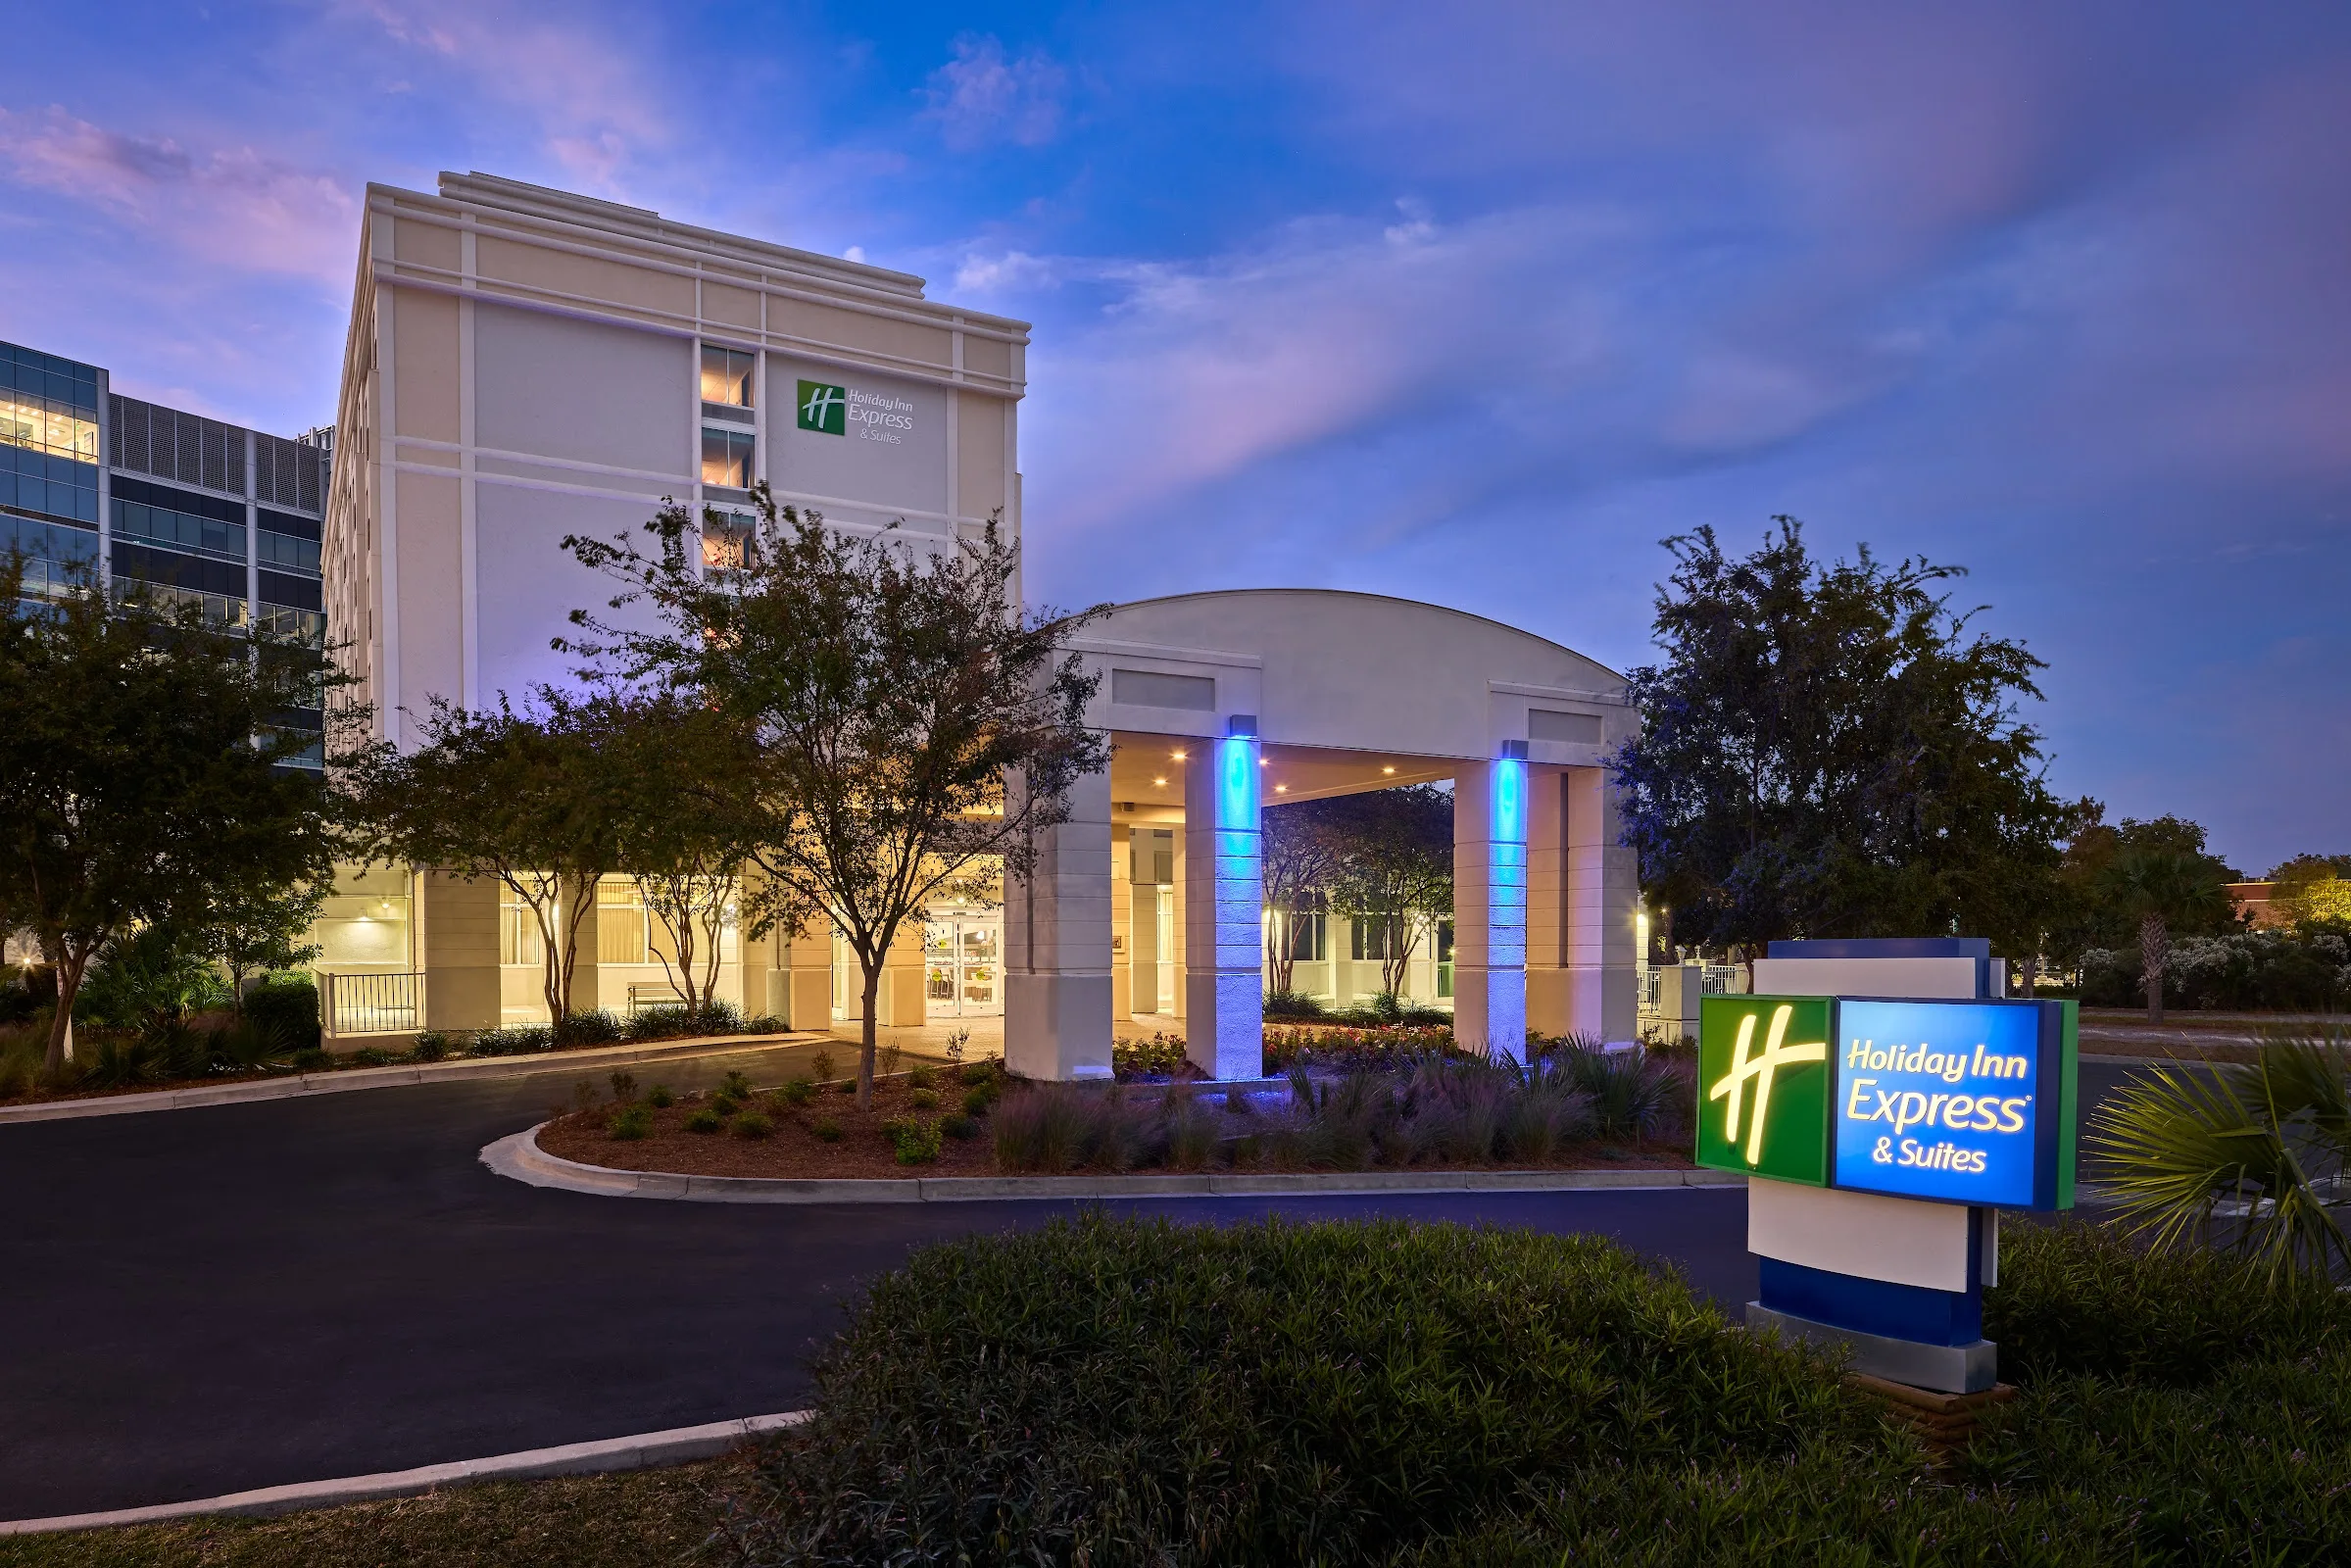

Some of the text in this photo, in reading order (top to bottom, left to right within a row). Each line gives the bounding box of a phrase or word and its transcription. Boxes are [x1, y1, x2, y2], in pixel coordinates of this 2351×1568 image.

[848, 389, 913, 412] Holiday Inn
[848, 404, 913, 430] Express
[859, 428, 902, 445] & Suites
[1846, 1039, 2028, 1083] Holiday Inn
[1873, 1136, 1987, 1173] & Suites
